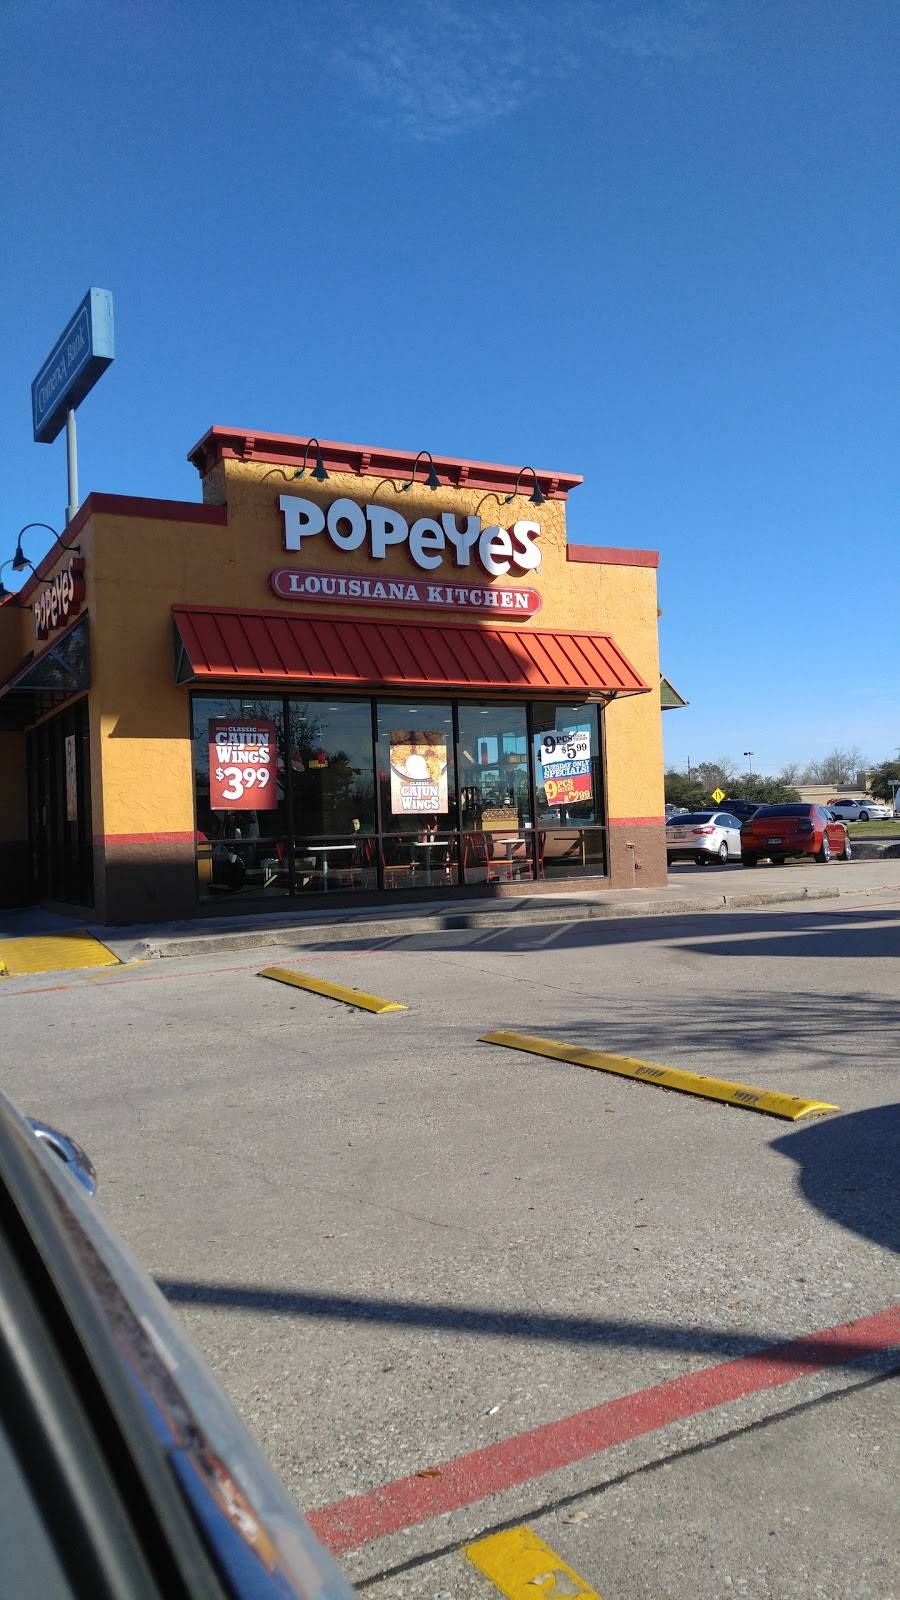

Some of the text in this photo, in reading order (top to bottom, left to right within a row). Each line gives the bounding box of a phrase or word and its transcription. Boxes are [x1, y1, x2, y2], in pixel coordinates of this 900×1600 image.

[67, 327, 86, 366] Bank
[288, 574, 530, 609] LOUISIANA KITCHEN
[215, 732, 269, 750] CAJUN
[543, 735, 556, 754] 9
[556, 735, 572, 744] PCS
[216, 745, 270, 764] WINGS
[544, 762, 572, 772] TUESDAY
[544, 766, 590, 779] SPECIALS!
[400, 785, 439, 799] CAJUN
[544, 779, 574, 800] 9 PCS
[400, 796, 440, 810] WINGS
